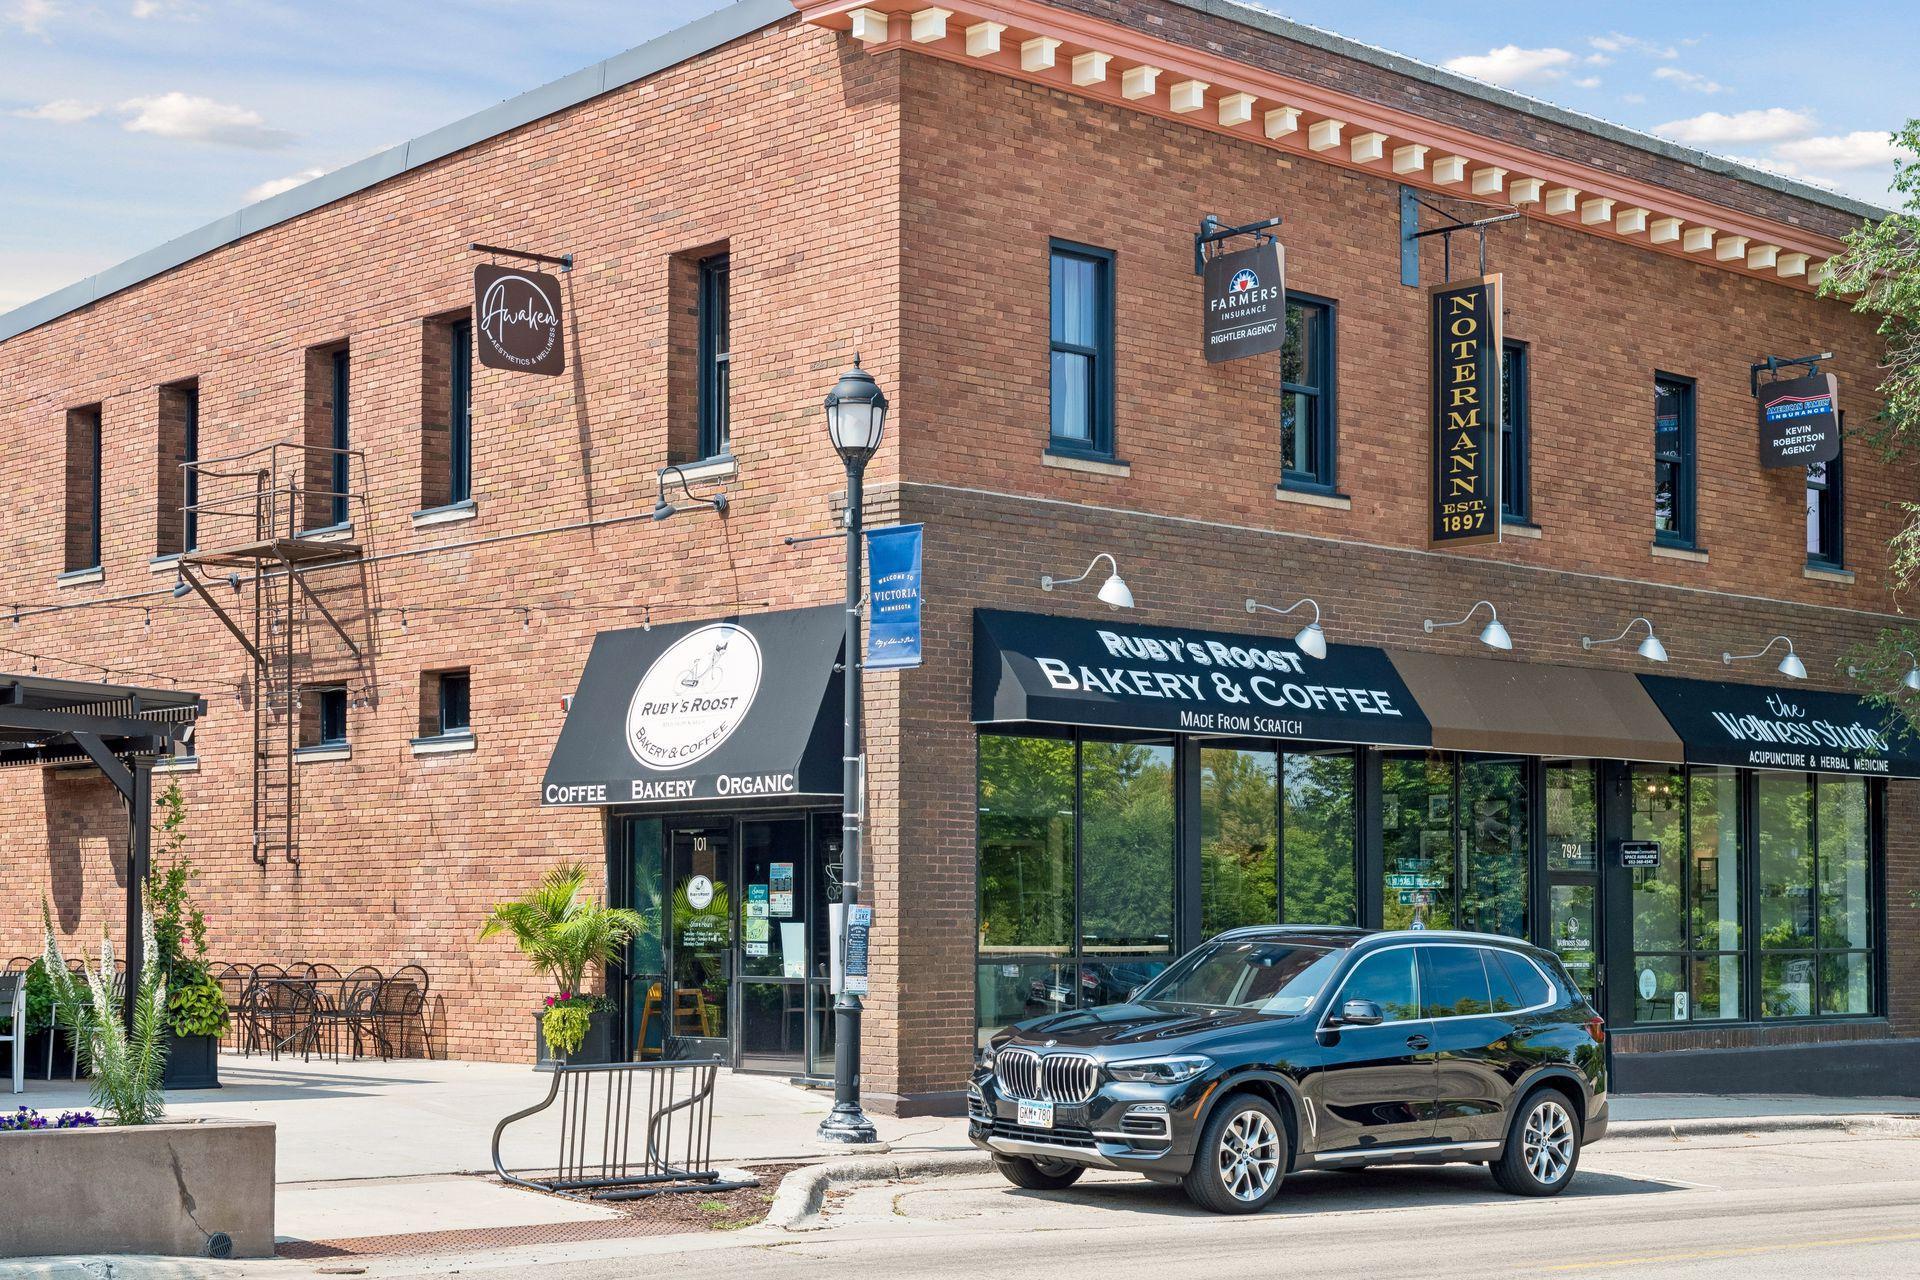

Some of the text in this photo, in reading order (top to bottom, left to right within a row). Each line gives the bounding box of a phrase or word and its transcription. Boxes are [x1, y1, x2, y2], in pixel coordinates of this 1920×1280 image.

[1211, 286, 1278, 312] FARMERS
[481, 285, 558, 343] Awaken
[1221, 304, 1267, 321] INSURANCE
[1211, 323, 1278, 345] RIGHTLER AGENCY
[490, 339, 530, 366] AESTHETICS
[537, 327, 556, 362] WELLNESS
[1447, 292, 1481, 497] NOTERMANN
[1771, 407, 1825, 420] INSURANCE
[1773, 432, 1825, 447] ROBERTSON
[1785, 425, 1812, 436] KEVIN
[1781, 443, 1816, 456] AGENCY
[1443, 500, 1487, 515] EST.
[1443, 513, 1485, 532] 1897
[878, 574, 905, 584] WELCOME
[874, 588, 917, 601] VICTORIA
[880, 604, 911, 612] MINNESOTA
[1095, 630, 1305, 674] RUBY'S ROOST
[1034, 657, 1402, 717] BAKERY & COFFEE
[641, 696, 739, 716] RUBY'S ROOST
[1765, 693, 1805, 718] the
[1180, 710, 1302, 735] MADE FROM SCRATCH
[1711, 711, 1889, 751] Wellness Studio
[635, 720, 728, 759] BAKERY & COFFEE
[1749, 750, 1889, 772] ACUPUNCTURE & HERBAL MEDICINE
[546, 773, 794, 803] COFFEE BAKERY ORGANIC
[693, 837, 707, 851] 101
[1562, 844, 1582, 859] 7924
